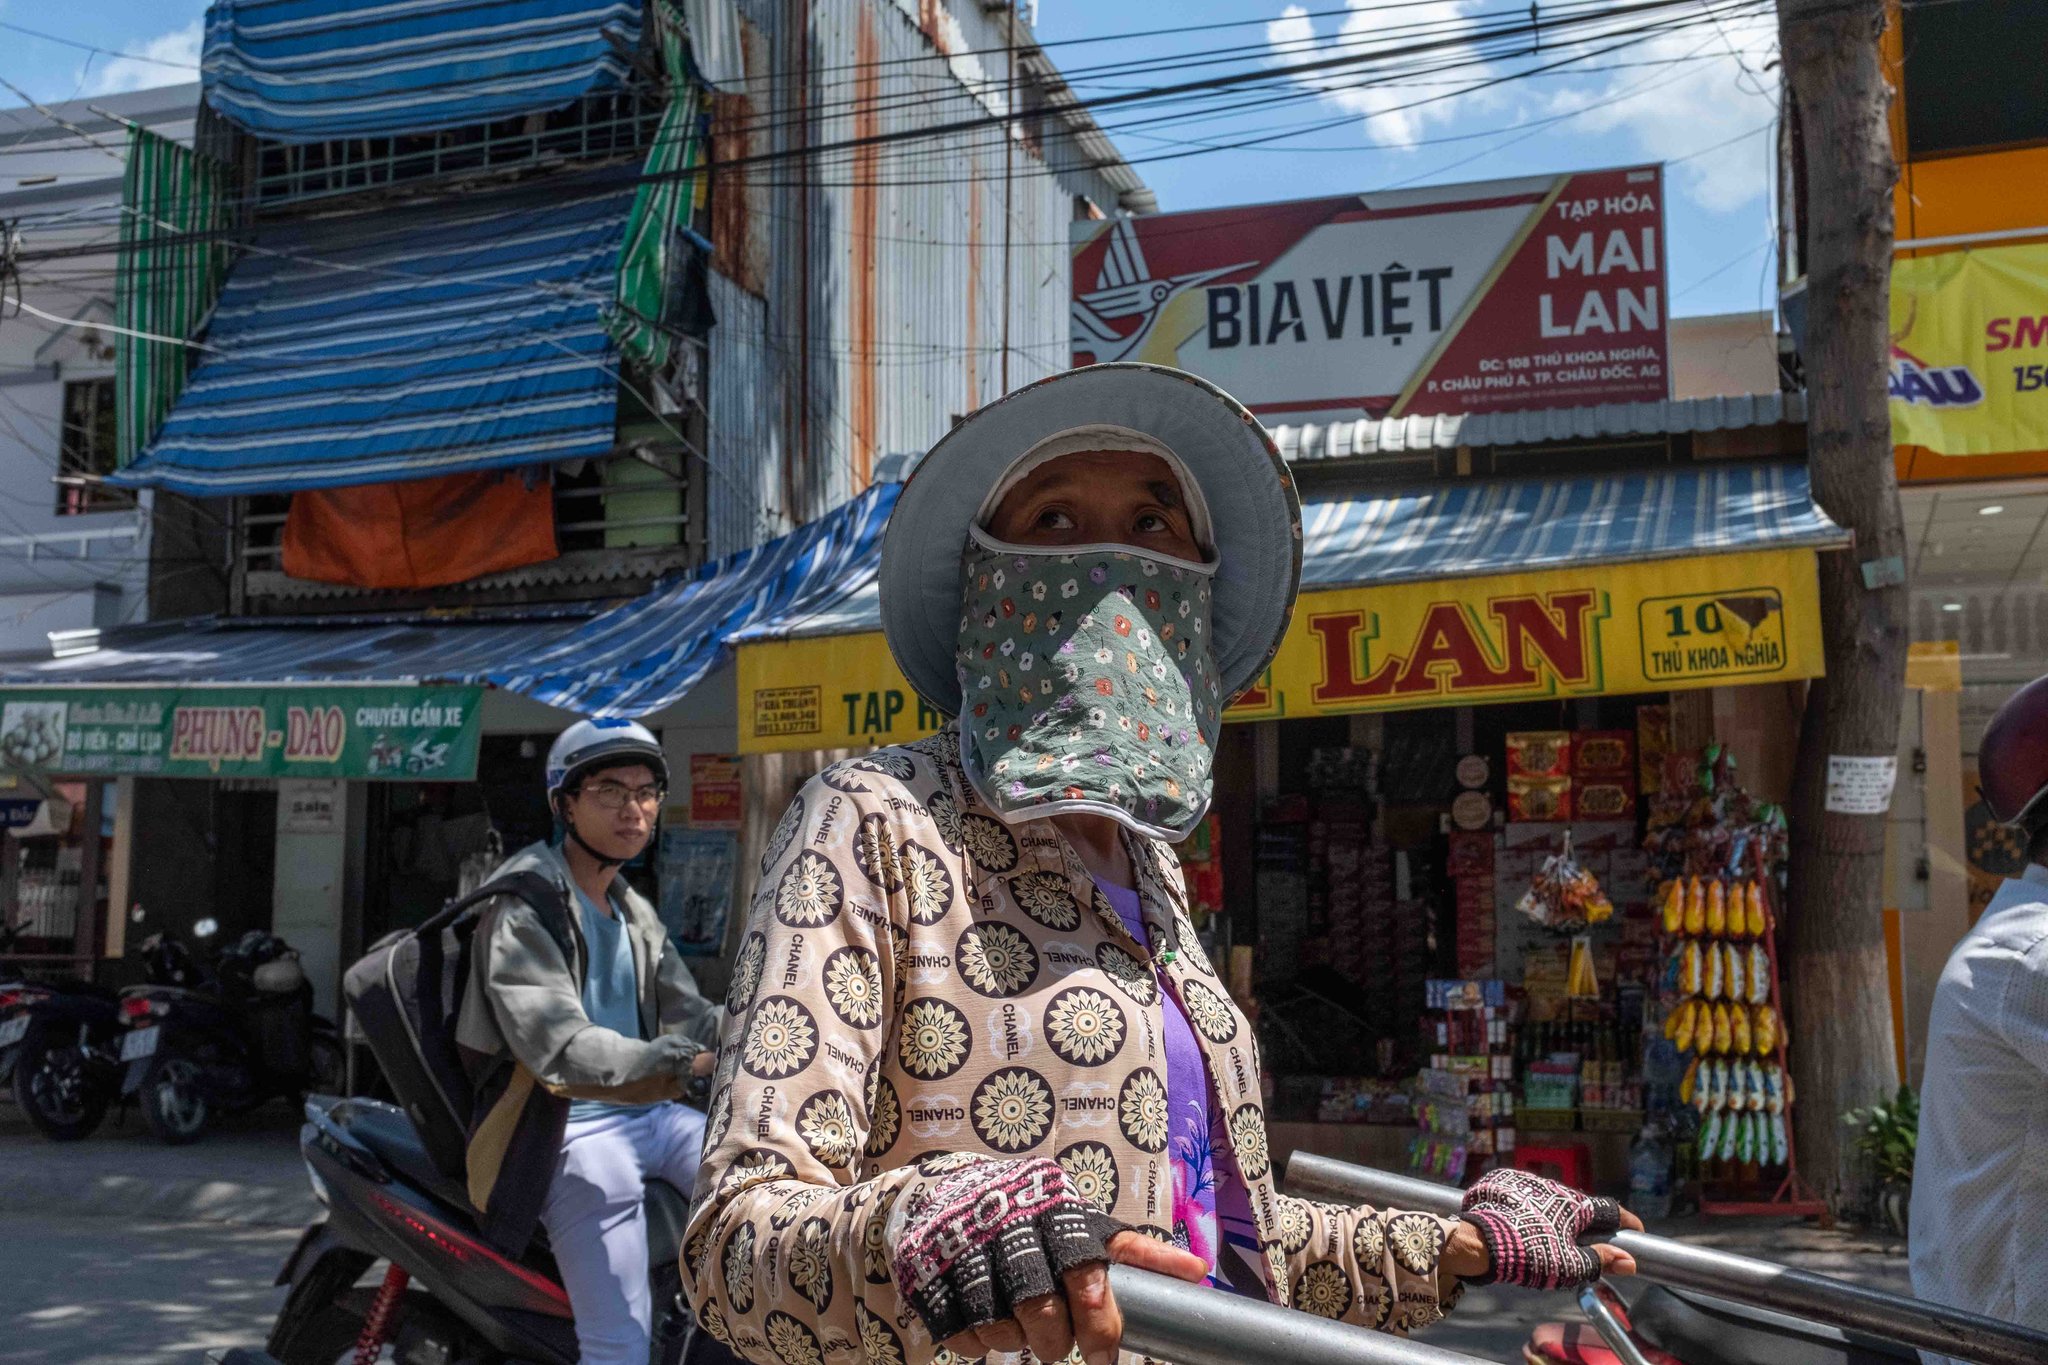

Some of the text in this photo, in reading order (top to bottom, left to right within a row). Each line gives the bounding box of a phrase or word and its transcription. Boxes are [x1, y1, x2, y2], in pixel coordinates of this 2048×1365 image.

[1557, 193, 1655, 222] TẠP HÓA
[1546, 227, 1656, 278] MAI
[1207, 261, 1453, 349] BIA VIỆT
[1539, 286, 1659, 338] LAN
[1565, 350, 1606, 365] KHOA
[1442, 375, 1482, 392] CHÂU
[1556, 367, 1597, 382] CHÂU
[1308, 588, 1597, 706] LAN
[1652, 641, 1682, 674] THỦ
[1688, 646, 1729, 671] KHOA
[444, 707, 464, 727] XE
[815, 795, 842, 845] CHANEL
[883, 797, 929, 818] CHANEL
[1021, 837, 1060, 849] CHANEL
[849, 900, 892, 931] HANEL
[783, 933, 804, 990] CHANEL
[909, 955, 950, 968] CHANE
[1042, 951, 1095, 967] CHANEL
[1002, 1003, 1020, 1060] CHANEL
[1141, 1009, 1155, 1061] CHANEL
[824, 1042, 864, 1074] CHANEL
[1230, 1046, 1249, 1099] CHANEL
[757, 1085, 775, 1142] CHANEL
[906, 1107, 964, 1122] CHANEL
[1060, 1097, 1115, 1111] CHANEL
[1146, 1160, 1156, 1219] CHANEL
[1257, 1183, 1276, 1236] CHANEL
[1399, 1291, 1439, 1305] CHANEL
